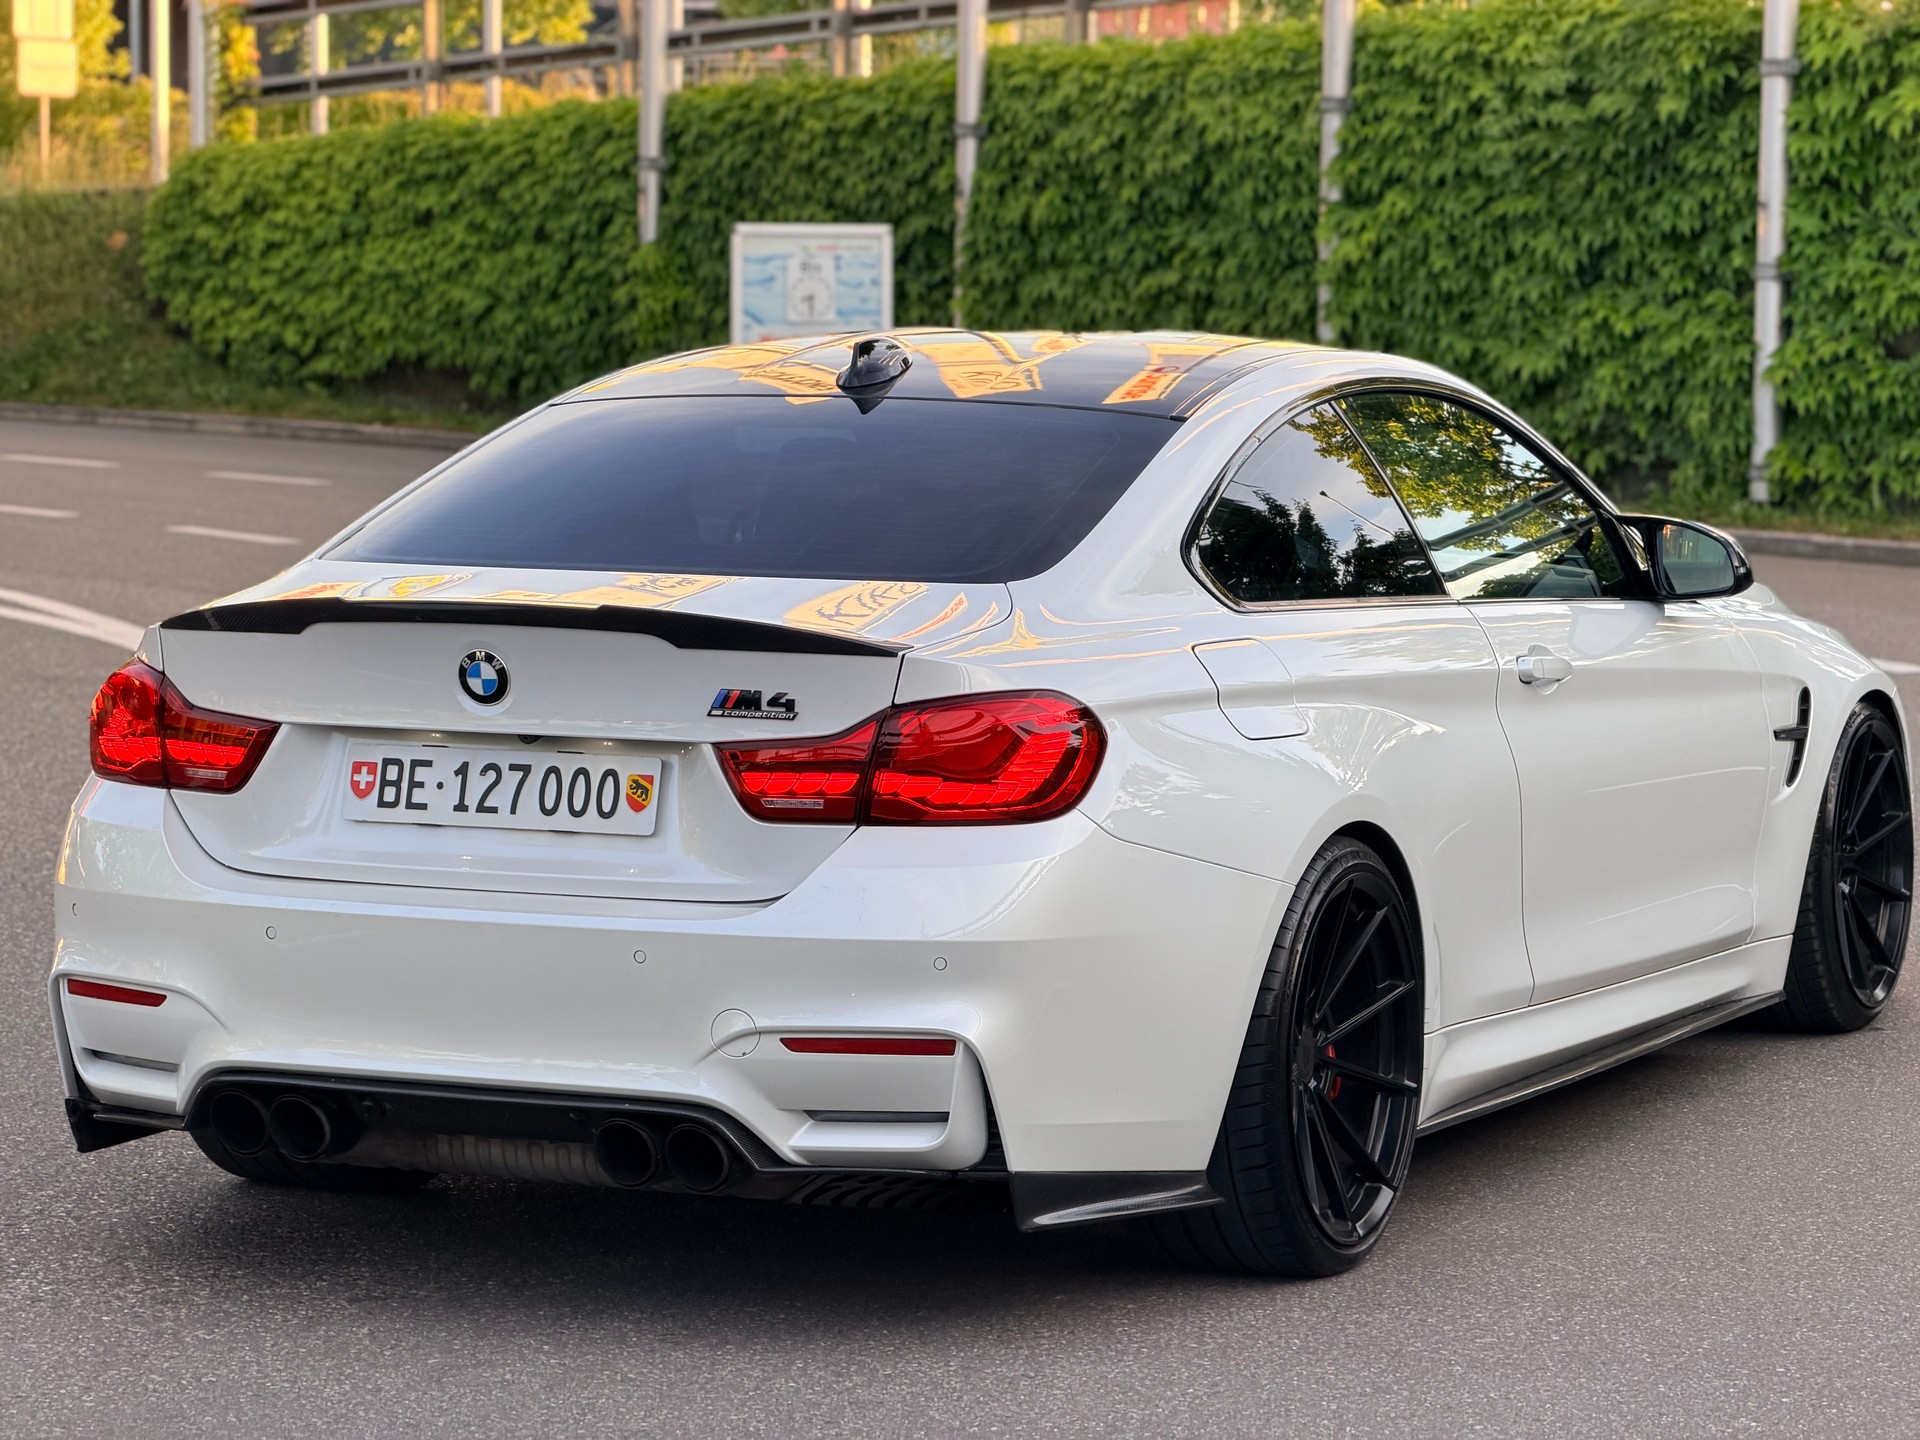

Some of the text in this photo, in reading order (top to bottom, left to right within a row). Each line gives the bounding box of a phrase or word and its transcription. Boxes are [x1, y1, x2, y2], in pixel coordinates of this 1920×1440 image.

[461, 651, 504, 670] BMW
[722, 689, 796, 712] M4
[723, 710, 794, 719] competition
